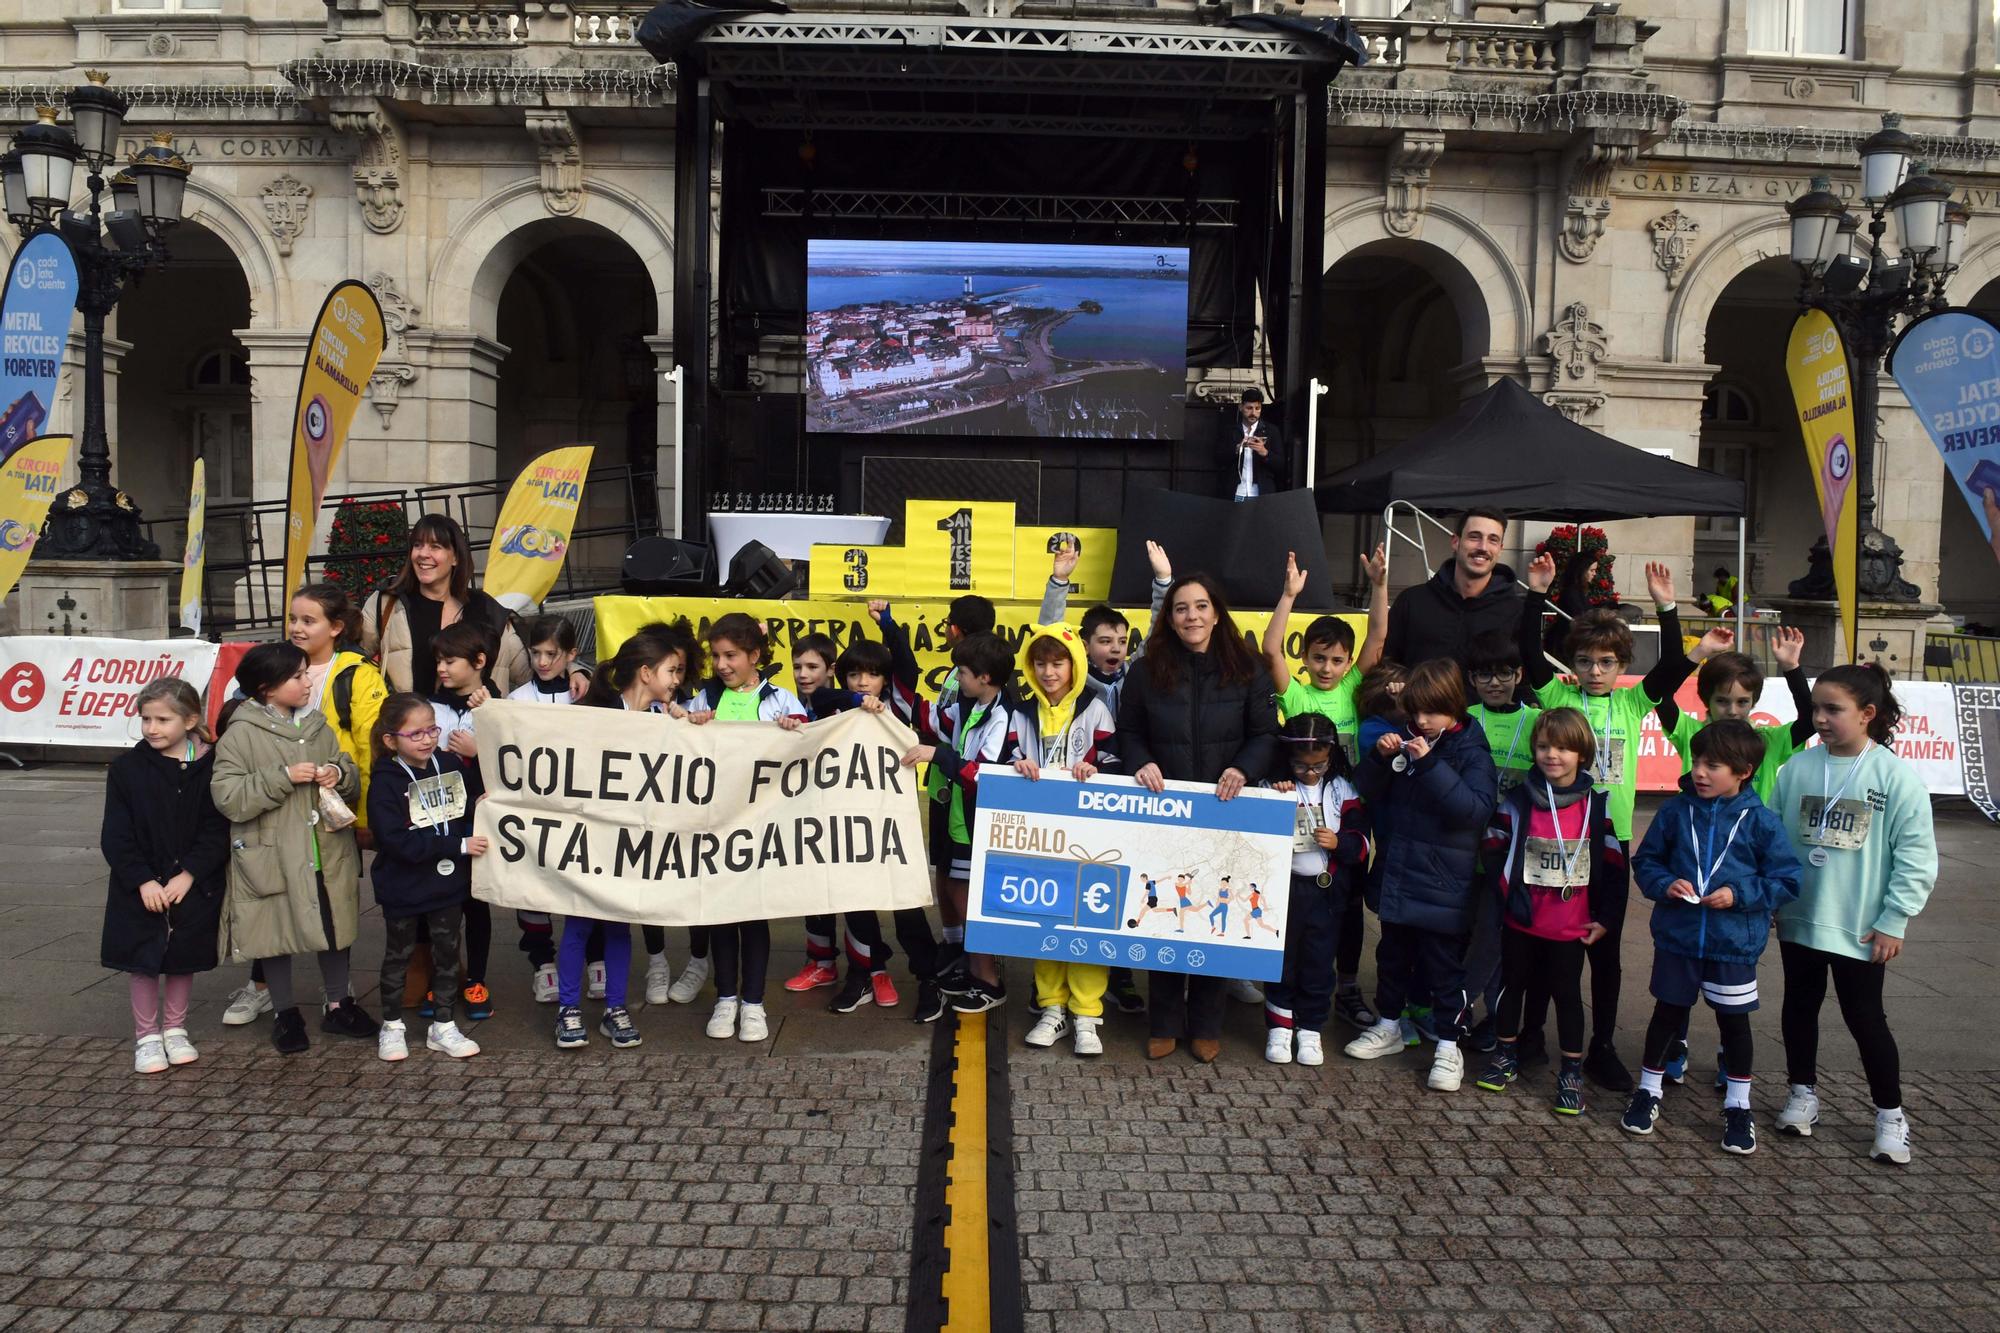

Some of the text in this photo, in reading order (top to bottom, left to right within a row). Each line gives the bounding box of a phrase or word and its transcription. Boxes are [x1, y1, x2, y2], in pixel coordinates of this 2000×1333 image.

[221, 138, 333, 156] CORVÑA
[1633, 174, 1740, 194] CABEZA
[37, 256, 58, 268] cada
[38, 268, 54, 279] lata
[37, 280, 66, 290] cuenta
[5, 312, 42, 331] METAL
[4, 335, 59, 355] RECYCLES
[320, 326, 349, 358] CIRCULA
[319, 340, 345, 371] TU LATA
[5, 358, 56, 378] FOREVER
[315, 355, 359, 396] AL AMARILLO
[543, 481, 579, 503] LATA
[62, 654, 185, 685] A CORUÑA
[58, 684, 139, 718] É DEPO
[499, 743, 904, 805] COLEXIO FOGAR
[1077, 790, 1193, 819] DECATHLON
[991, 812, 1026, 826] TARJETA
[989, 823, 1066, 854] REGALO
[1000, 875, 1111, 914] 500 €
